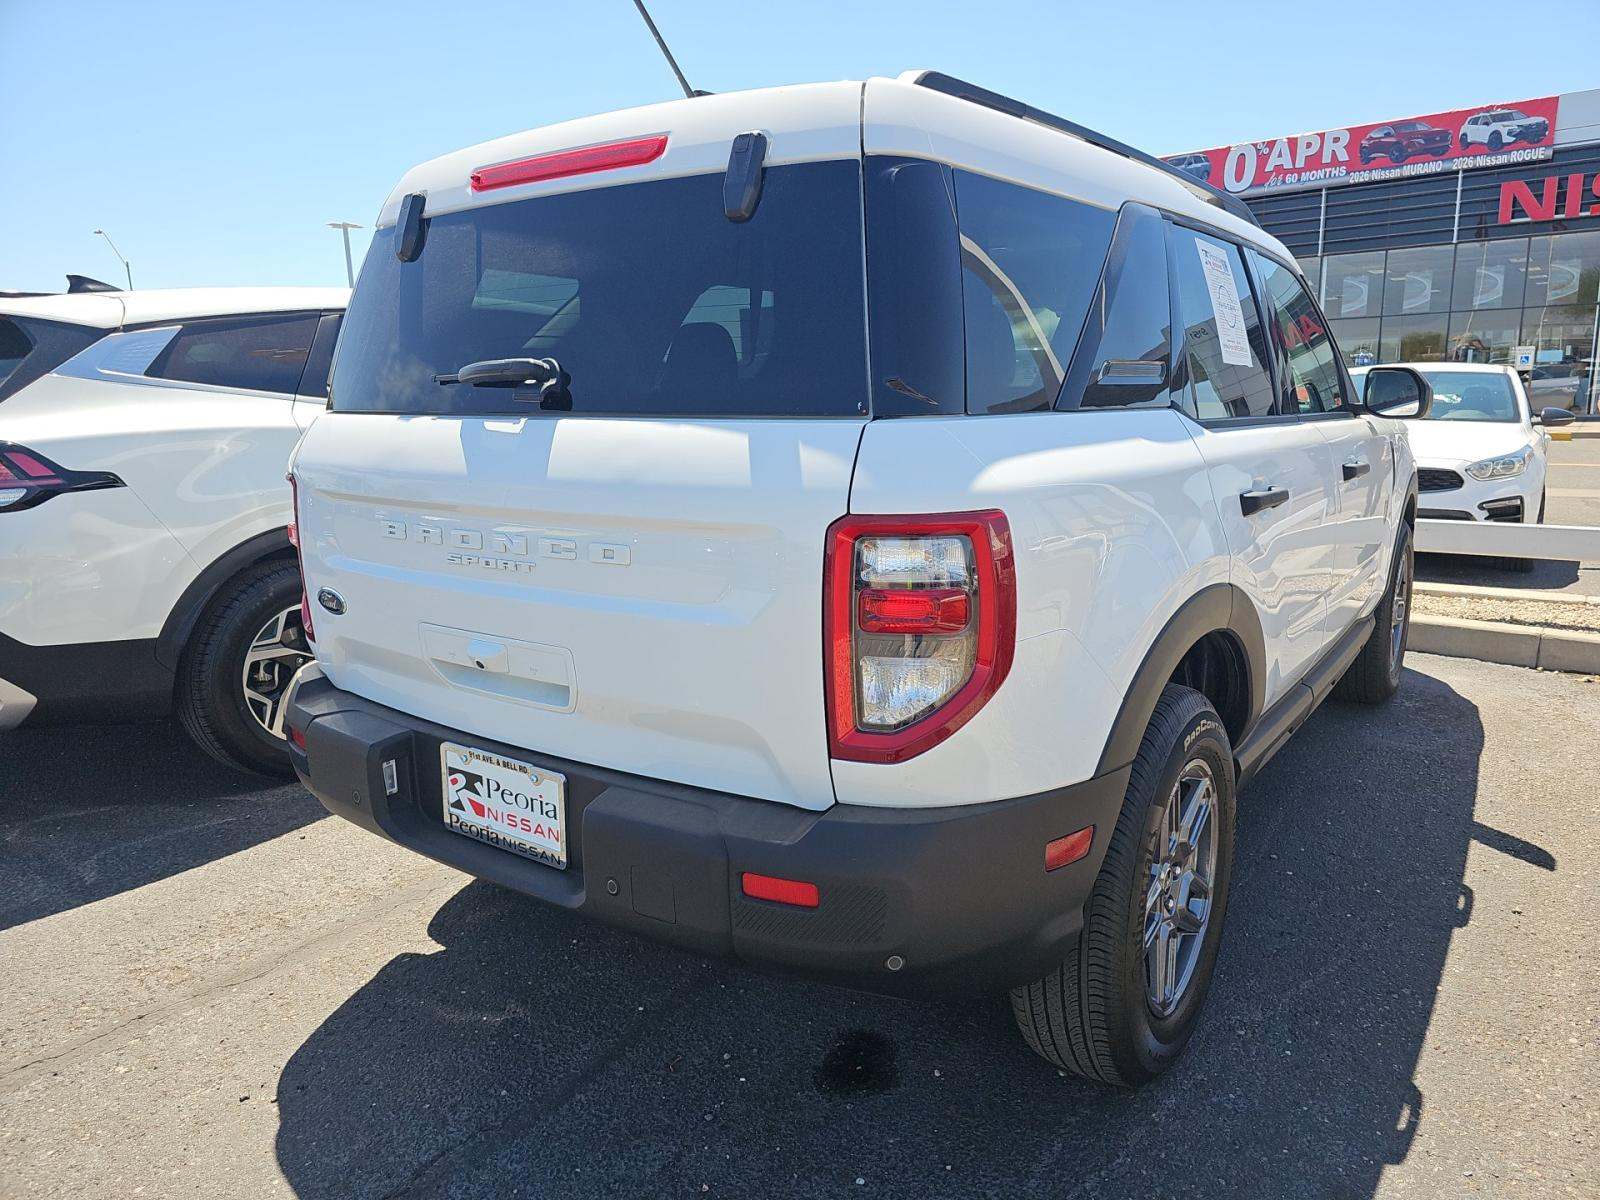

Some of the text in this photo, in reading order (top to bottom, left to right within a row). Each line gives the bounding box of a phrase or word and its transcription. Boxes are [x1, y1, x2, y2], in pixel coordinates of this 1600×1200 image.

[1265, 129, 1351, 172] APR
[1452, 147, 1546, 169] 2026 Nissan ROGUE
[1264, 166, 1347, 192] for 60 MONTHS
[1349, 160, 1443, 183] 2026 Nissan MURANO
[1498, 173, 1600, 224] NI
[380, 519, 632, 566] BRONCO
[447, 553, 536, 573] SPORT
[496, 758, 501, 767] &
[502, 760, 518, 771] BELL
[485, 778, 558, 820] Peoria
[450, 813, 500, 845] Peoria
[487, 806, 560, 842] NISSAN
[502, 837, 561, 865] NISSAN
